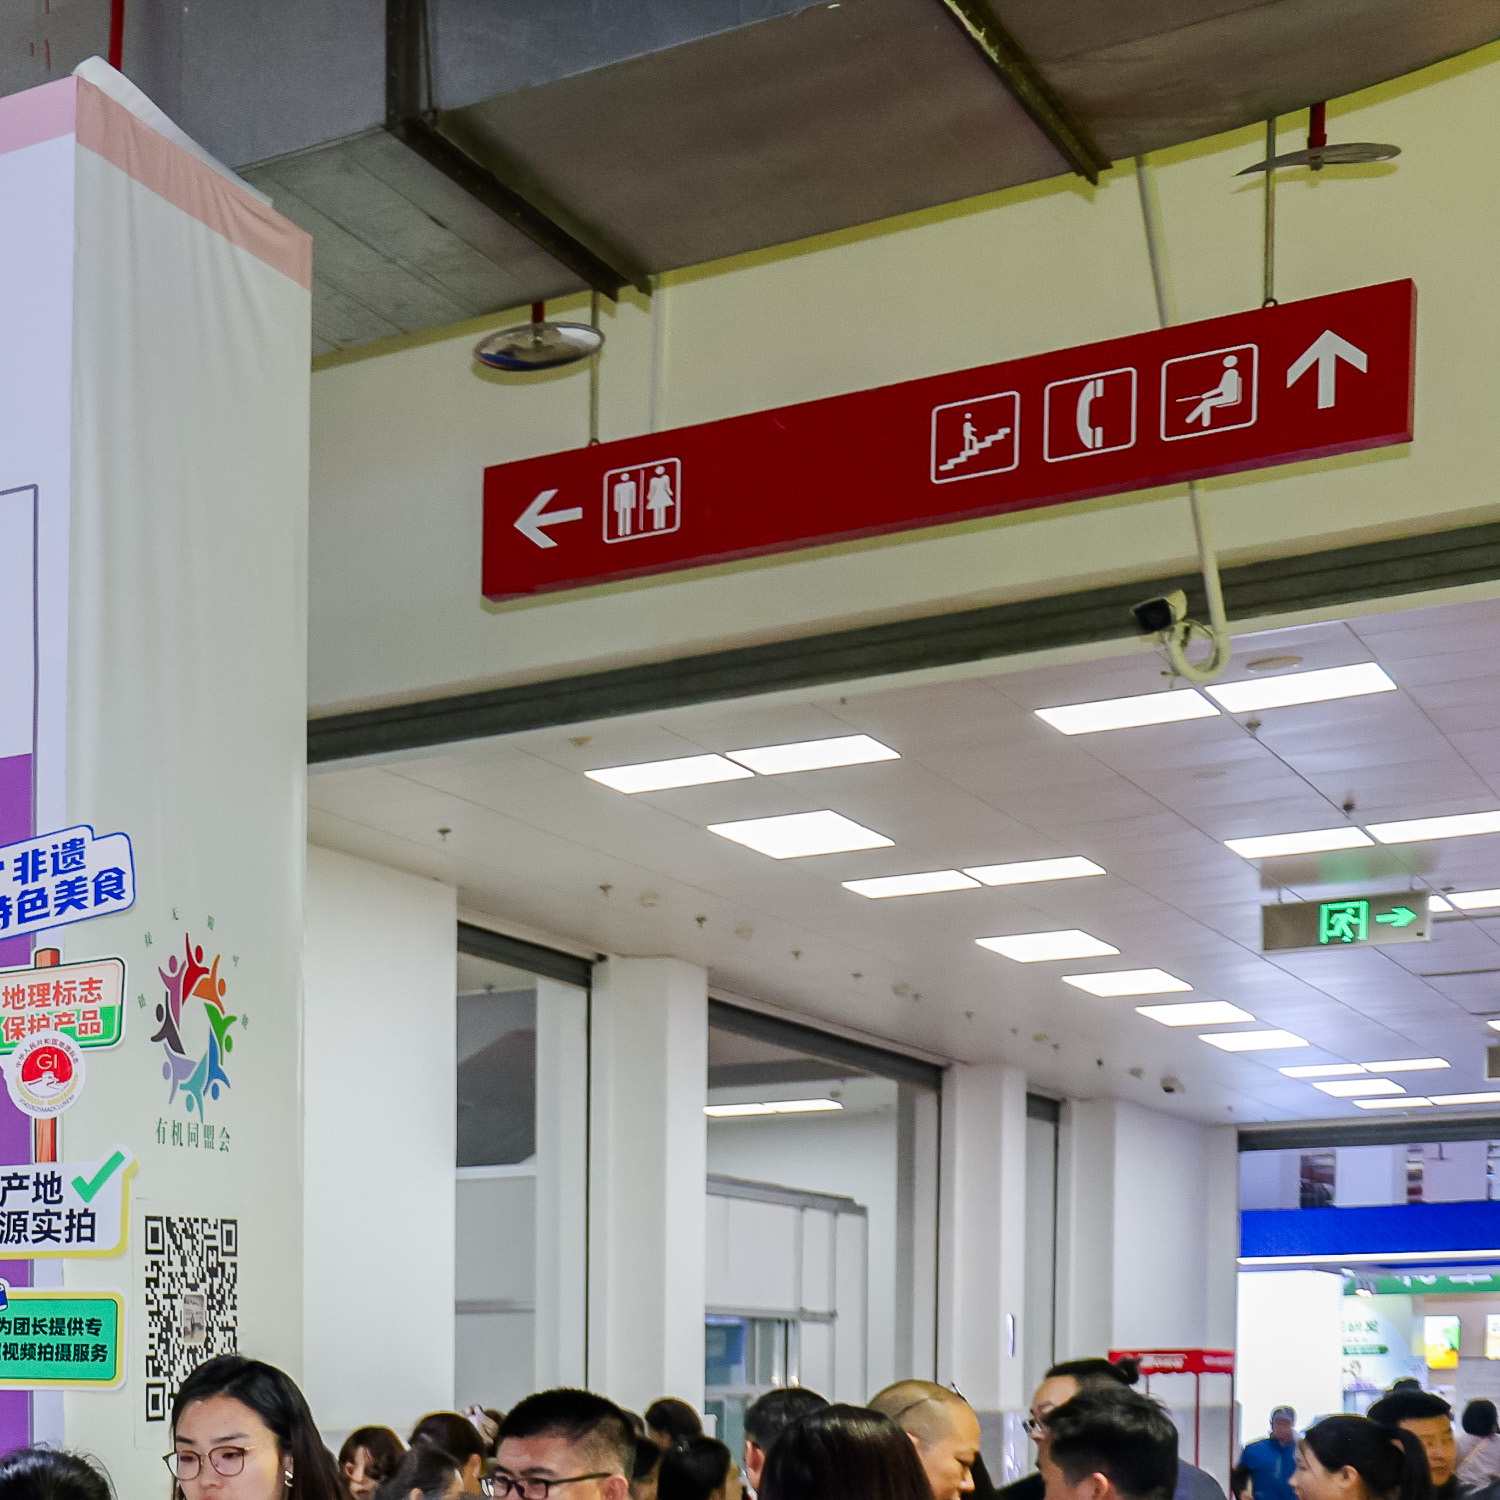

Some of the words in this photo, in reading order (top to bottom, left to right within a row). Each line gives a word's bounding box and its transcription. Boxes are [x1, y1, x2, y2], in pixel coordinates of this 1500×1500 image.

[12, 836, 87, 887] 非遗
[1, 976, 103, 1010] 地理标志
[1, 1009, 102, 1042] 保护产品
[36, 1053, 58, 1070] GI
[156, 1116, 232, 1153] 有机同盟会
